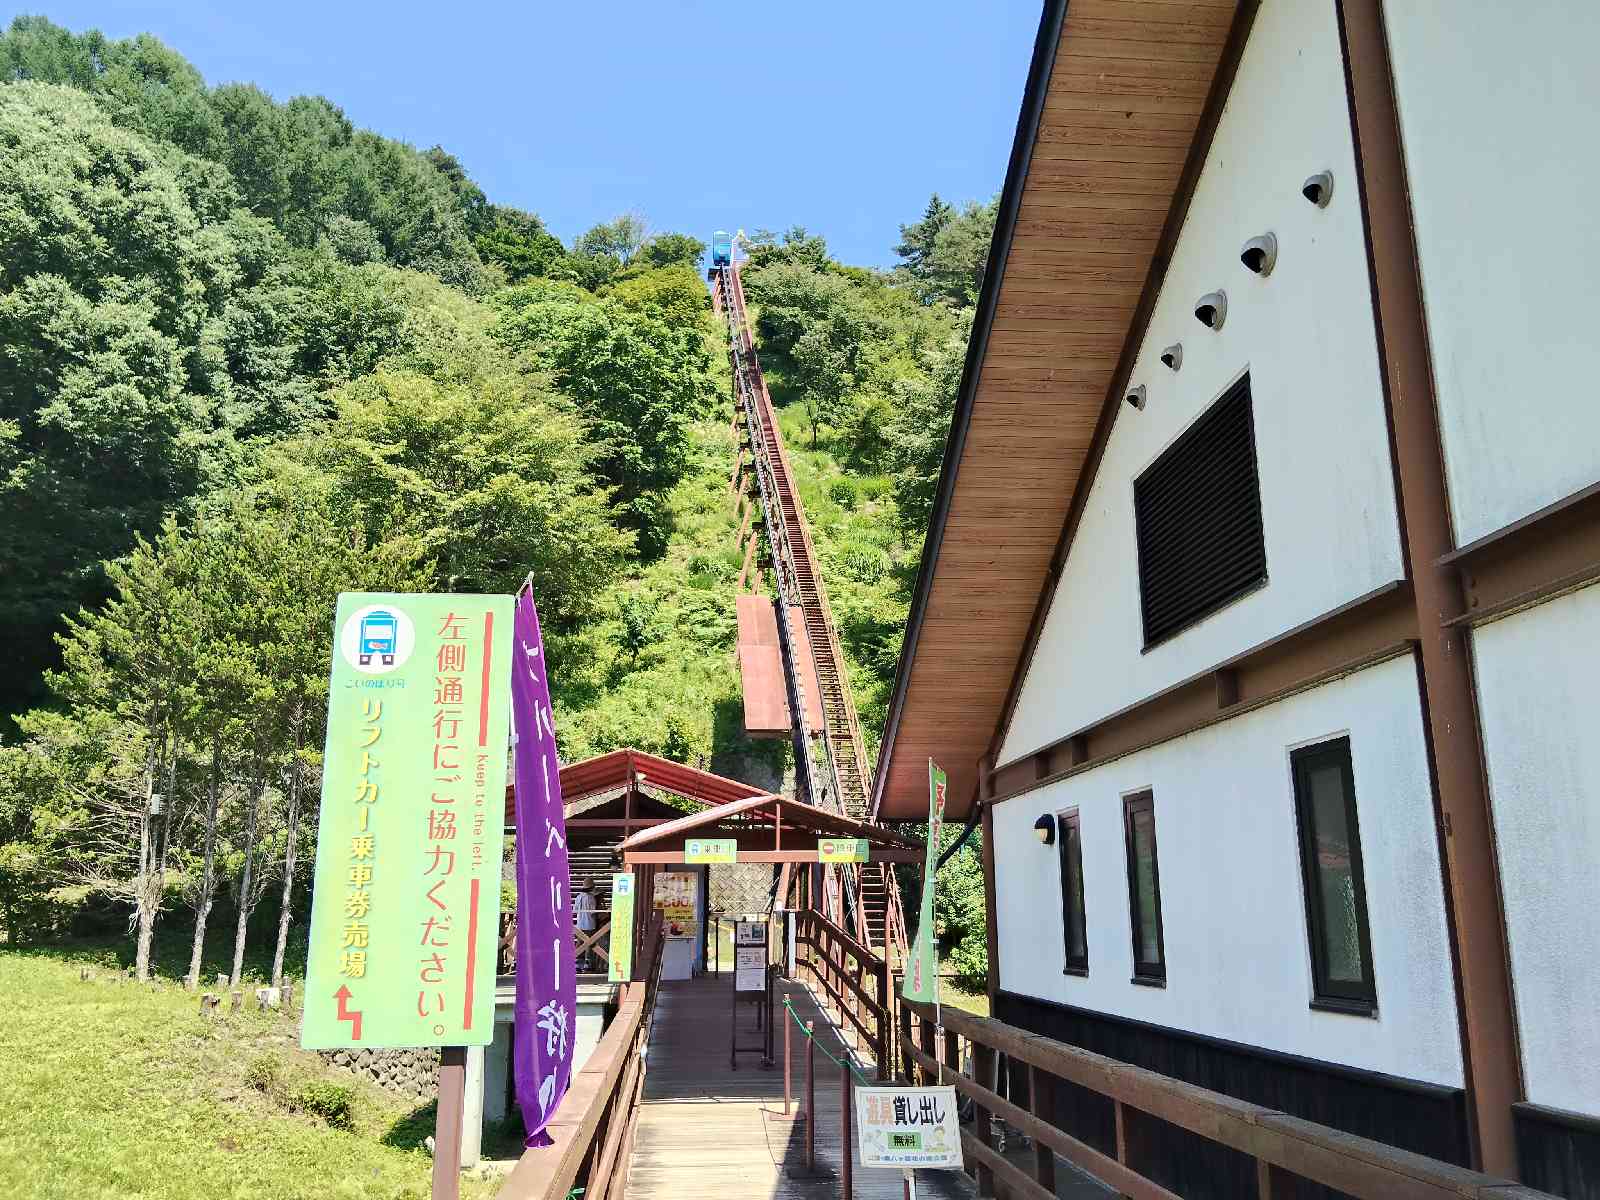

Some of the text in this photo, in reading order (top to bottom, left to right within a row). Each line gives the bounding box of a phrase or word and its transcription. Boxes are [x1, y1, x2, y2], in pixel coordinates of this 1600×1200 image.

[475, 754, 489, 787] Keep
[475, 793, 485, 806] to
[339, 698, 383, 978] リフトカー乗車券売場
[418, 612, 472, 1037] 左側通行にご協力ください。
[473, 814, 485, 836] the
